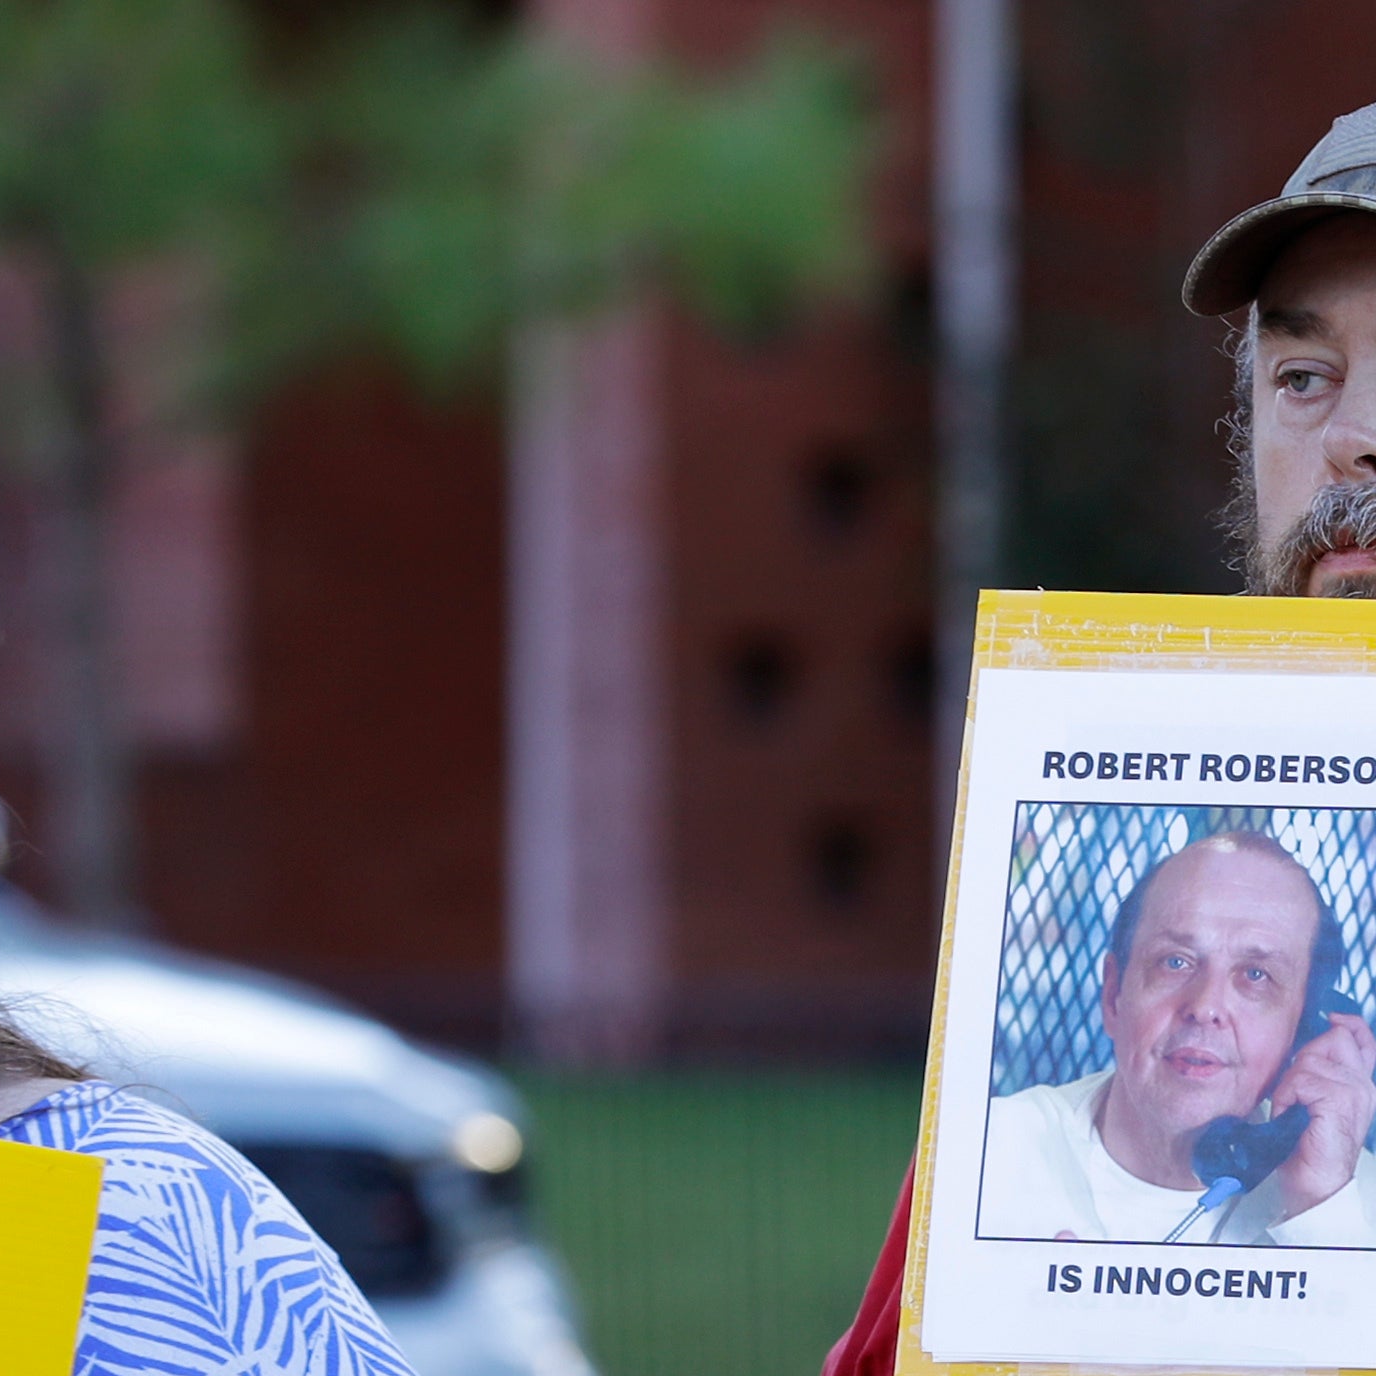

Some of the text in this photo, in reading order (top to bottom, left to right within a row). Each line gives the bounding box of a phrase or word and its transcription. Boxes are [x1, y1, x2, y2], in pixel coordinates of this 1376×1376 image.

[1042, 751, 1190, 780] ROBERT
[1047, 1264, 1308, 1300] IS INNOCENT!
